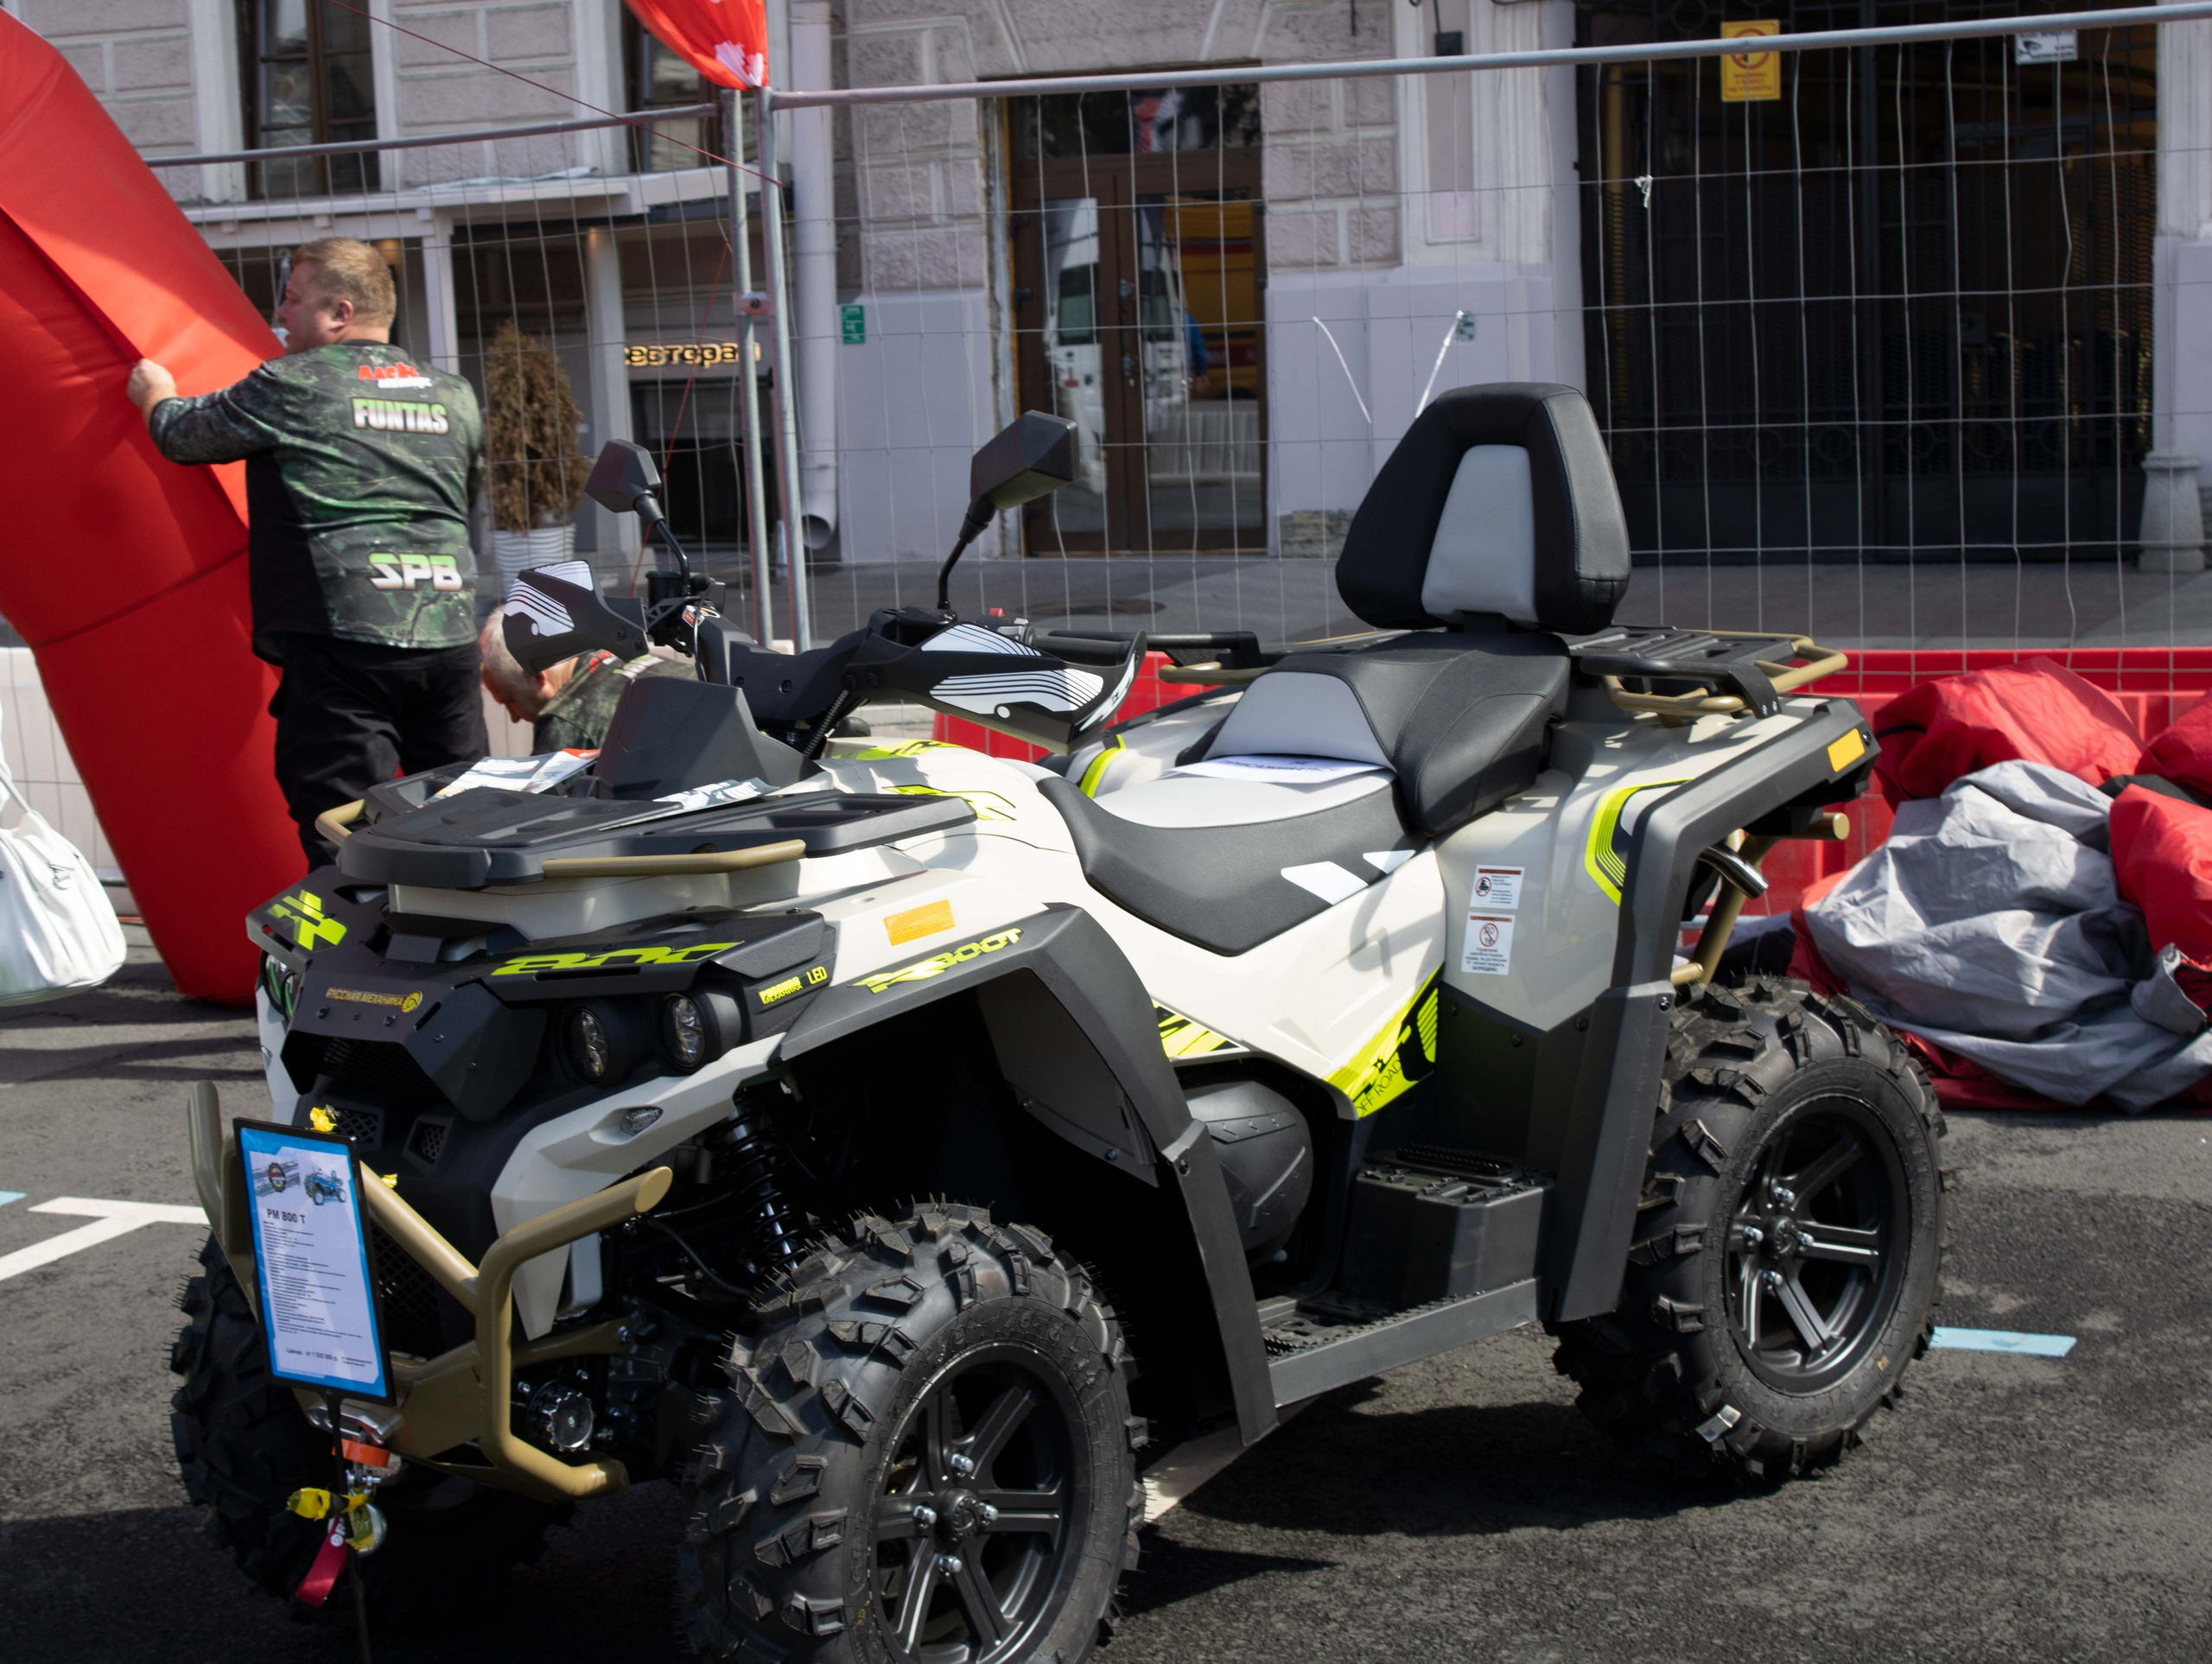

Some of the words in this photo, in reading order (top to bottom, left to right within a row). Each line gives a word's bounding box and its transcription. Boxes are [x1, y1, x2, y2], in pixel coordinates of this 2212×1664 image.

[624, 342, 761, 369] естора
[352, 397, 449, 435] FUNTAS
[368, 552, 463, 592] SPB
[805, 965, 828, 985] LED
[1374, 1059, 1402, 1097] ROAD
[282, 1211, 298, 1223] 800
